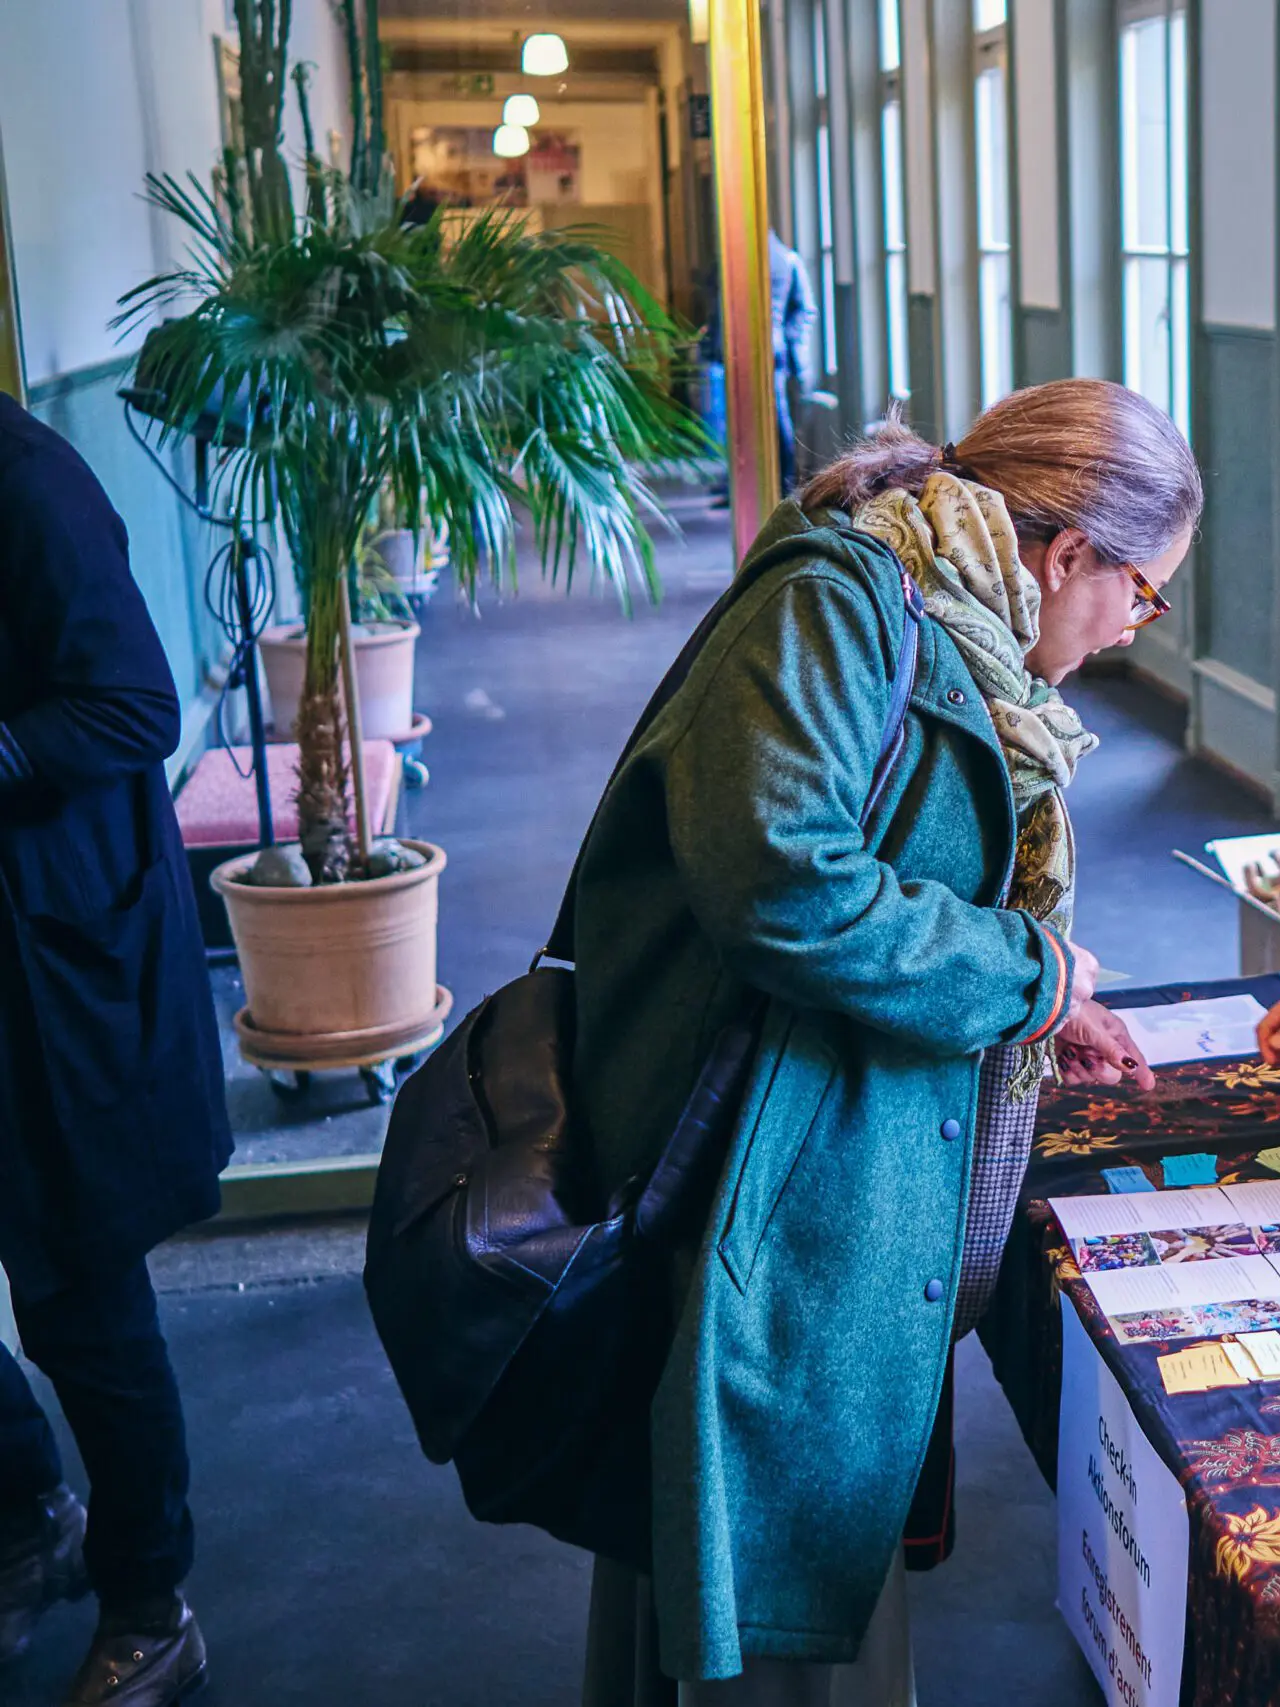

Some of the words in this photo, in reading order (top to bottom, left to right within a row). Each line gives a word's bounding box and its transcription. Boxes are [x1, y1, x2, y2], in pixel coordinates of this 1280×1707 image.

[1087, 1453, 1151, 1588] Aktionsforum
[1098, 1416, 1138, 1506] Check-in
[1081, 1528, 1152, 1690] Enregistrement
